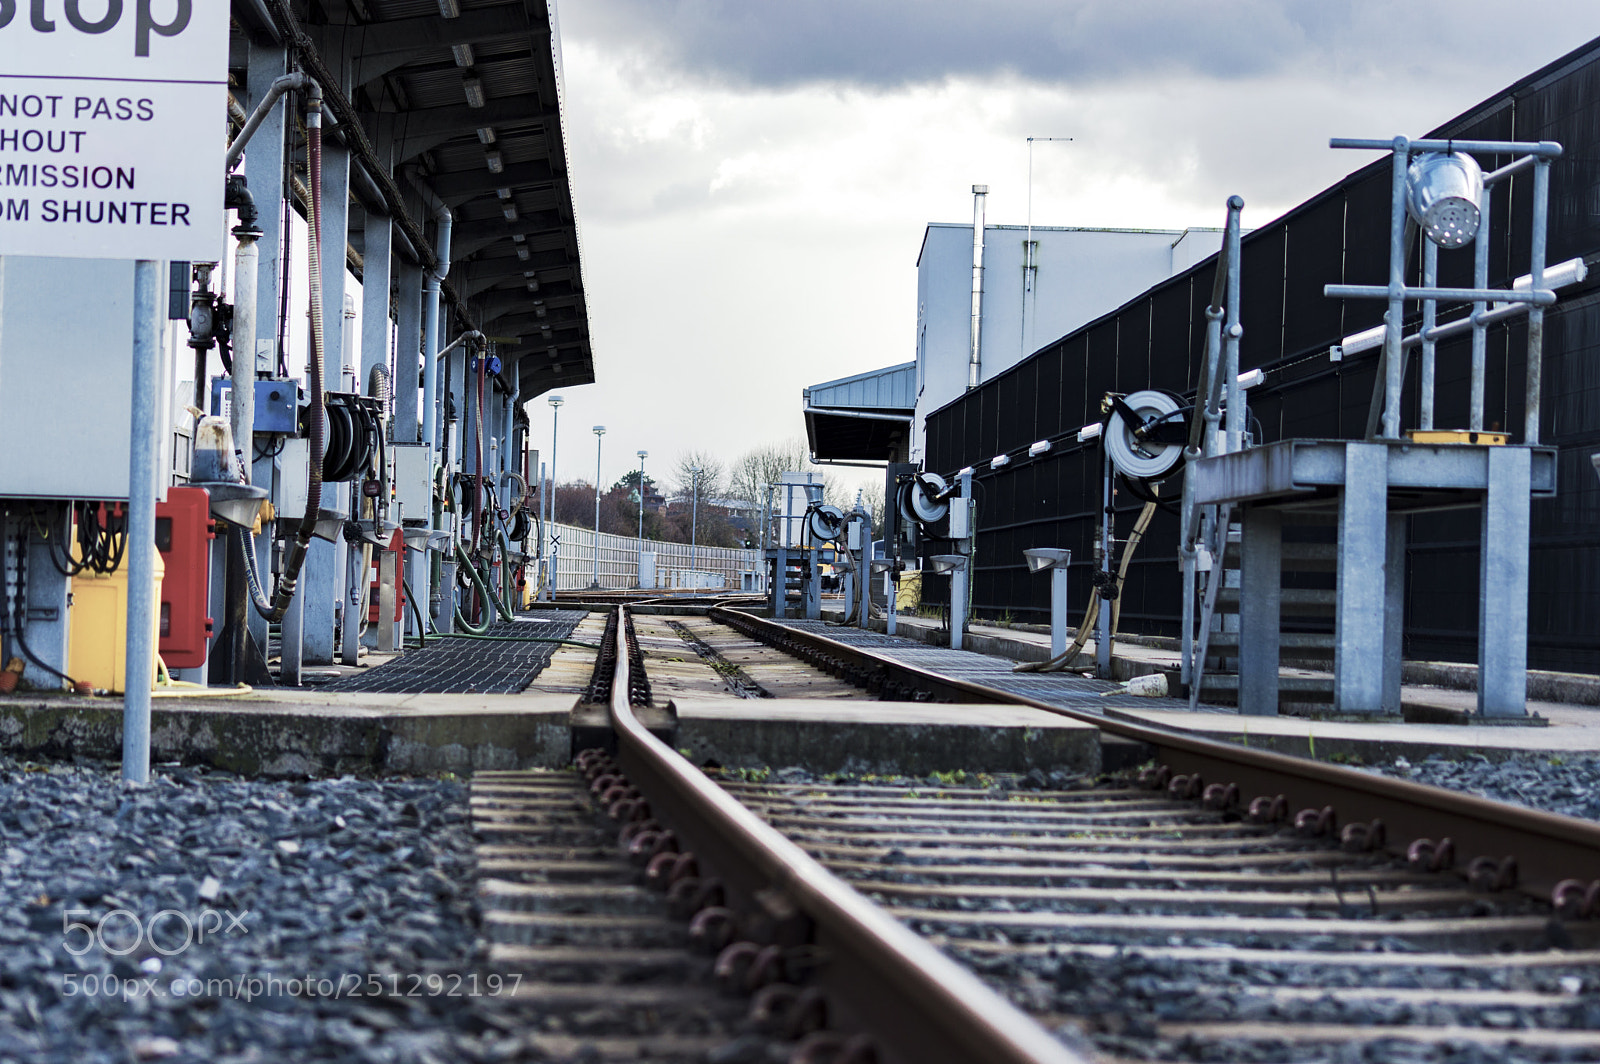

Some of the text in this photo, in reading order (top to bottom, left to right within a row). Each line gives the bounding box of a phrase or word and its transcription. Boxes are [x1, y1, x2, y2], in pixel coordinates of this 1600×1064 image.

[0, 0, 193, 57] op
[0, 94, 154, 121] NOT PASS
[0, 129, 87, 153] HOUT
[0, 164, 135, 189] MISSION
[0, 198, 191, 226] M SHUNTER
